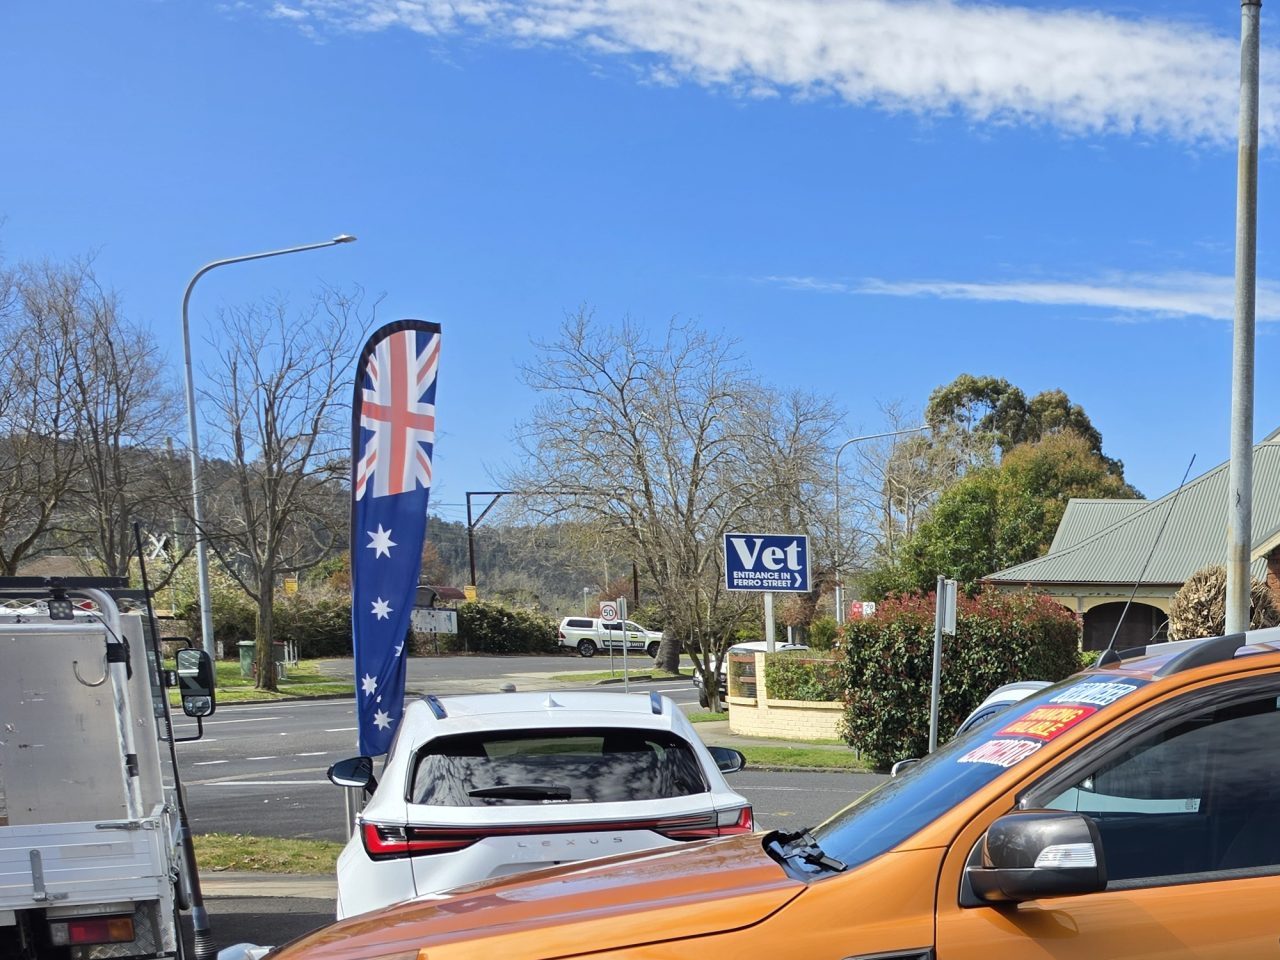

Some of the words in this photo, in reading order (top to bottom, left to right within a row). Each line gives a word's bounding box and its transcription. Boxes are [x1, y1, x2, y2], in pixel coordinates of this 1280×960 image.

[730, 537, 803, 570] Vet
[733, 571, 779, 579] ENTRANCE
[781, 572, 791, 580] IN
[762, 580, 792, 588] STREET
[603, 609, 614, 617] 50
[518, 836, 623, 848] LEXUS
